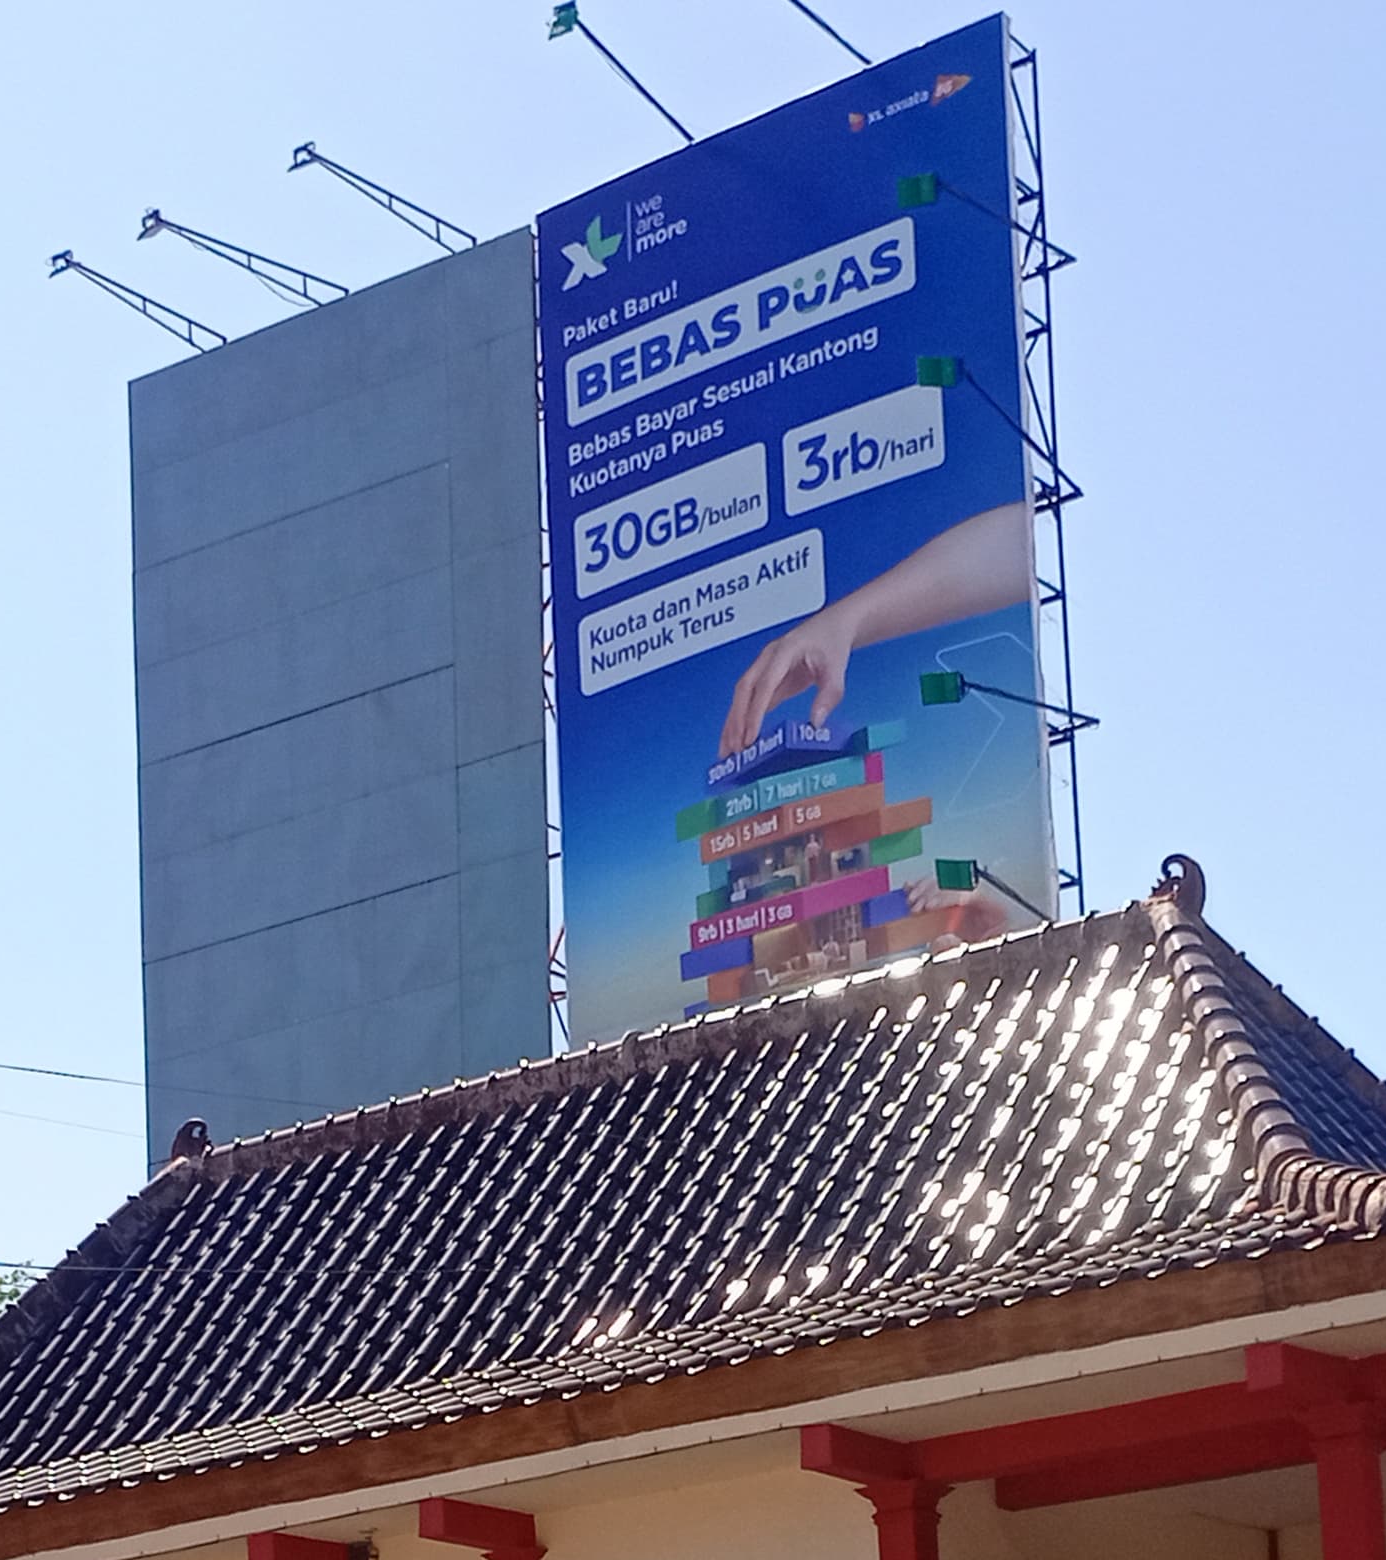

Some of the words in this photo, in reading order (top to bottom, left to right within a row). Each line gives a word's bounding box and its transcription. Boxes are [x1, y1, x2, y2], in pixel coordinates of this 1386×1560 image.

[634, 194, 663, 217] we
[635, 211, 664, 235] are
[636, 219, 688, 254] more
[561, 215, 623, 292] XL
[563, 307, 618, 348] Paket
[624, 279, 678, 320] Baru!
[576, 303, 742, 408] BEBAS
[568, 426, 631, 467] Bebas
[635, 399, 699, 438] Bayar
[702, 361, 776, 409] Sesuai
[779, 326, 879, 379] Kantong
[569, 439, 667, 498] Kuotanya
[671, 418, 724, 453] Puas
[589, 611, 647, 649] Kuota
[652, 595, 691, 623] dan
[695, 573, 750, 610] Masa
[755, 547, 810, 586] Aktif
[590, 627, 674, 675] Numpuk
[678, 605, 735, 640] Terus
